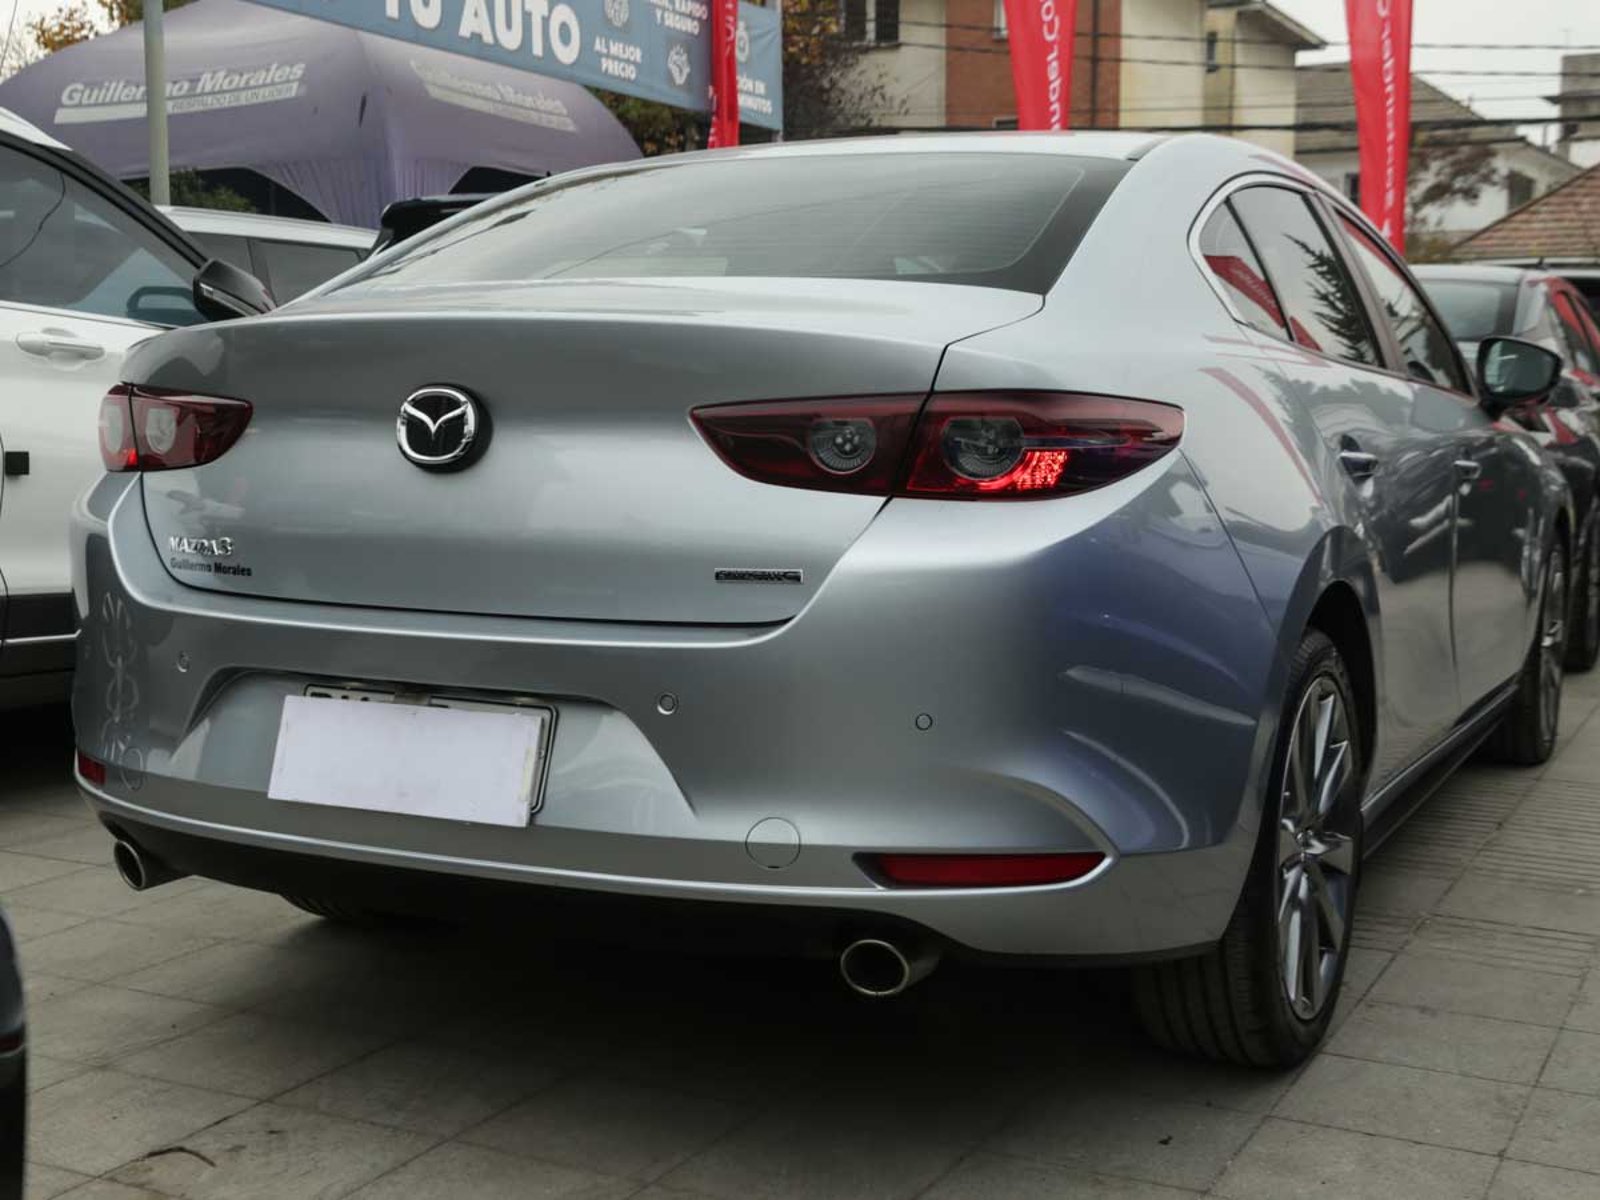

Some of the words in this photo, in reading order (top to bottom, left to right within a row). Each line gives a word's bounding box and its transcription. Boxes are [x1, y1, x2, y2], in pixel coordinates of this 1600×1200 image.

[458, 0, 581, 65] AUTO
[594, 35, 608, 54] AL
[609, 39, 642, 64] MEJOR
[196, 63, 307, 95] Morales
[601, 57, 636, 80] PRECIO
[169, 536, 234, 556] MAZDA3
[170, 557, 213, 573] Guillermo
[213, 562, 252, 577] Morales
